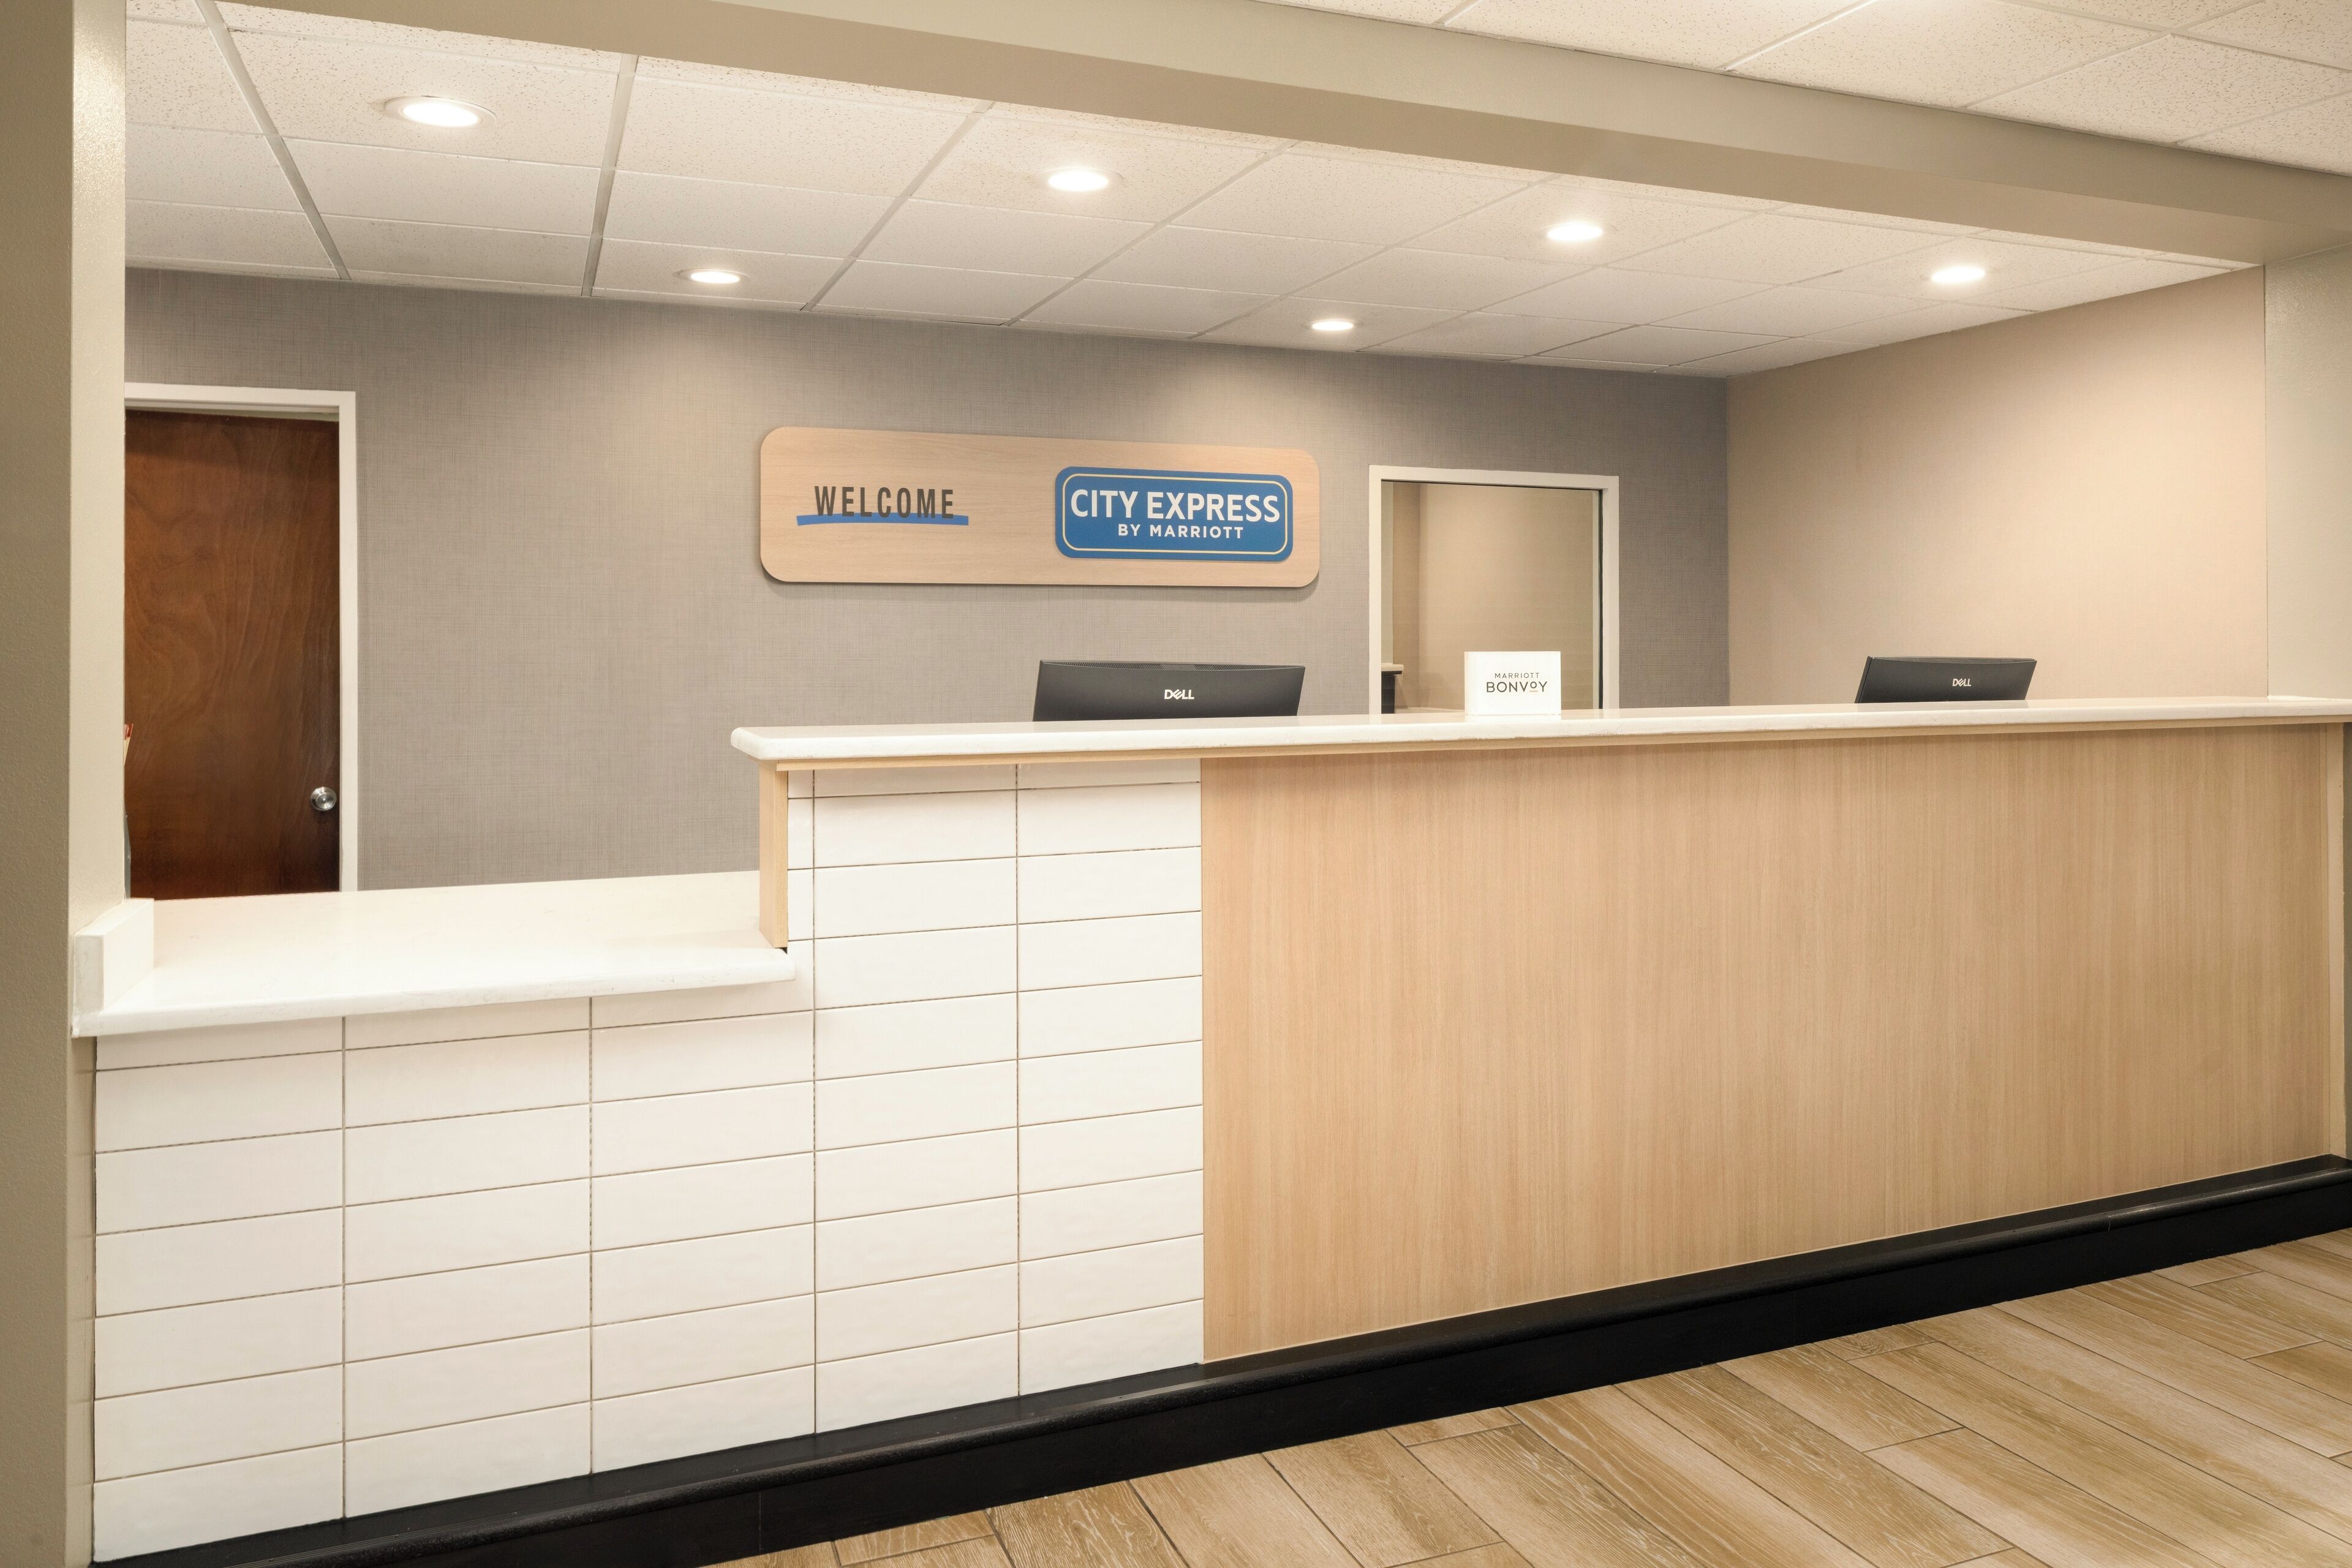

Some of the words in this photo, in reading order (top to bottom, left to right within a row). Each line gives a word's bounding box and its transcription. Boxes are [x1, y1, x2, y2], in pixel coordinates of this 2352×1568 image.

[815, 486, 953, 519] WELCOME
[1071, 489, 1139, 518] CITY
[1147, 492, 1280, 522] EXPRESS
[1118, 524, 1141, 536] BY
[1150, 524, 1244, 539] MARRIOTT
[1952, 678, 1972, 687] DELL
[1164, 689, 1195, 699] DELL
